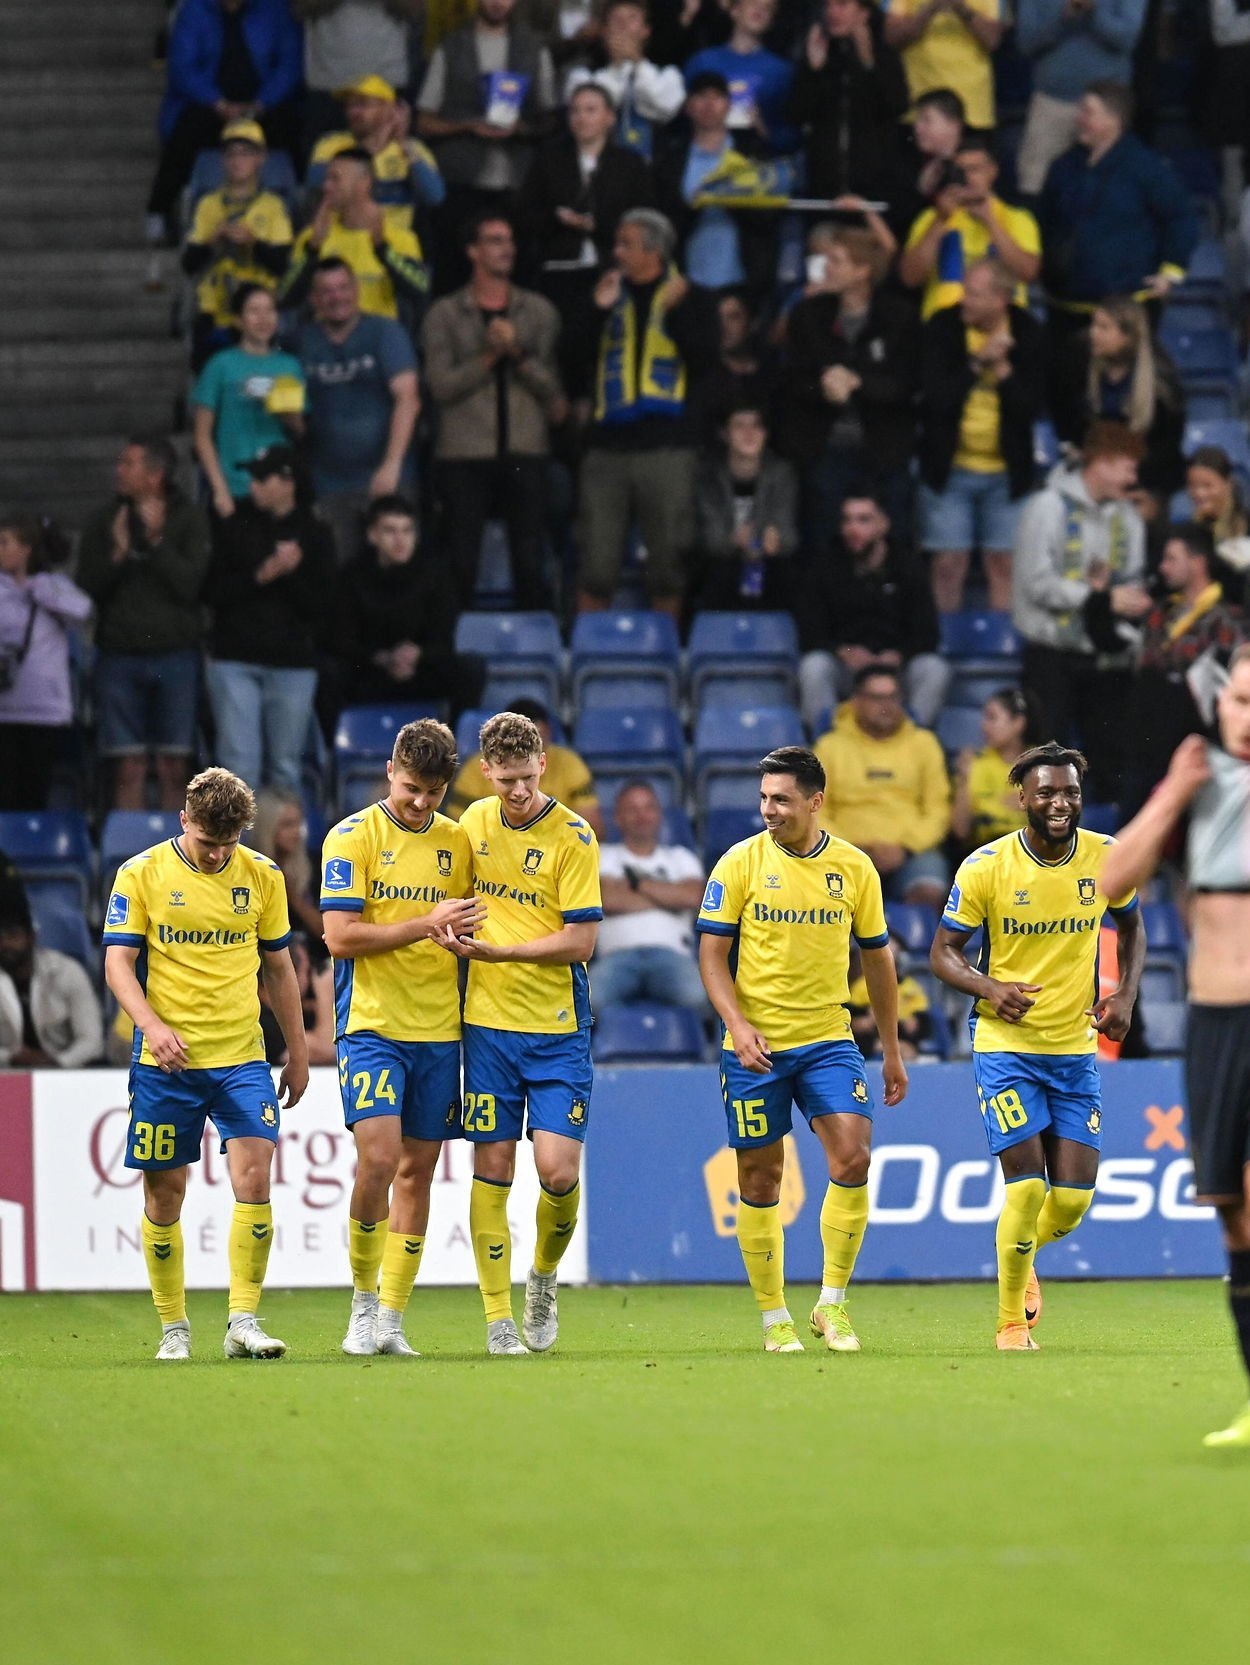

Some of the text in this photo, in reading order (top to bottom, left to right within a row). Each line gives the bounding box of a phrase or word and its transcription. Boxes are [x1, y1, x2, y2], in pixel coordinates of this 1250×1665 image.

[1002, 916, 1095, 936] Booztlet
[353, 1069, 397, 1110] 24
[464, 1093, 497, 1132] 23
[732, 1098, 769, 1138] 15
[990, 1088, 1028, 1134] 18
[134, 1121, 176, 1161] 36
